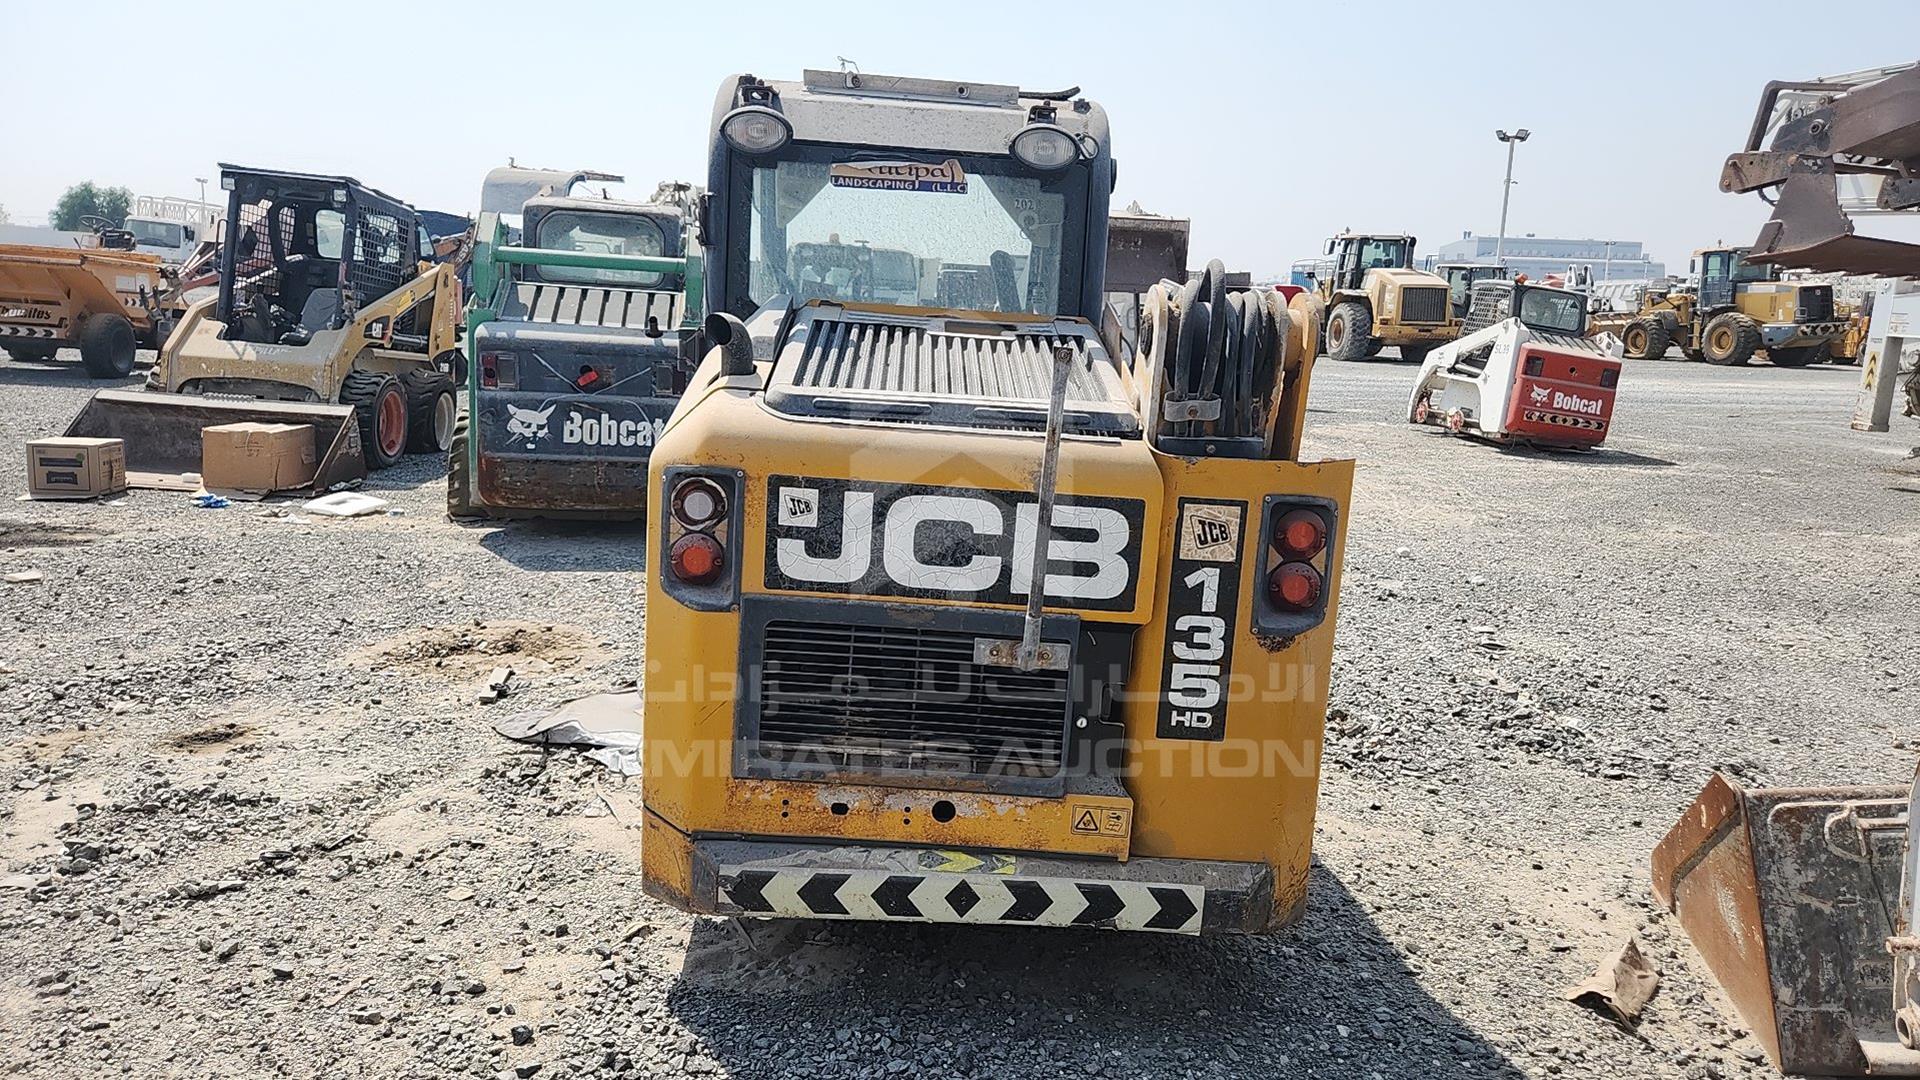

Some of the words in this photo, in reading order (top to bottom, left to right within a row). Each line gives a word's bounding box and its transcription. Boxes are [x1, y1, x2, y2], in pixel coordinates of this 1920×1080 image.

[831, 176, 914, 190] LANDSCAPING
[1552, 391, 1603, 415] Bobcat
[563, 411, 665, 447] Bobcat
[789, 497, 811, 516] JCB
[777, 487, 1130, 599] JCB
[1196, 519, 1229, 546] JCB
[1171, 711, 1212, 728] HD
